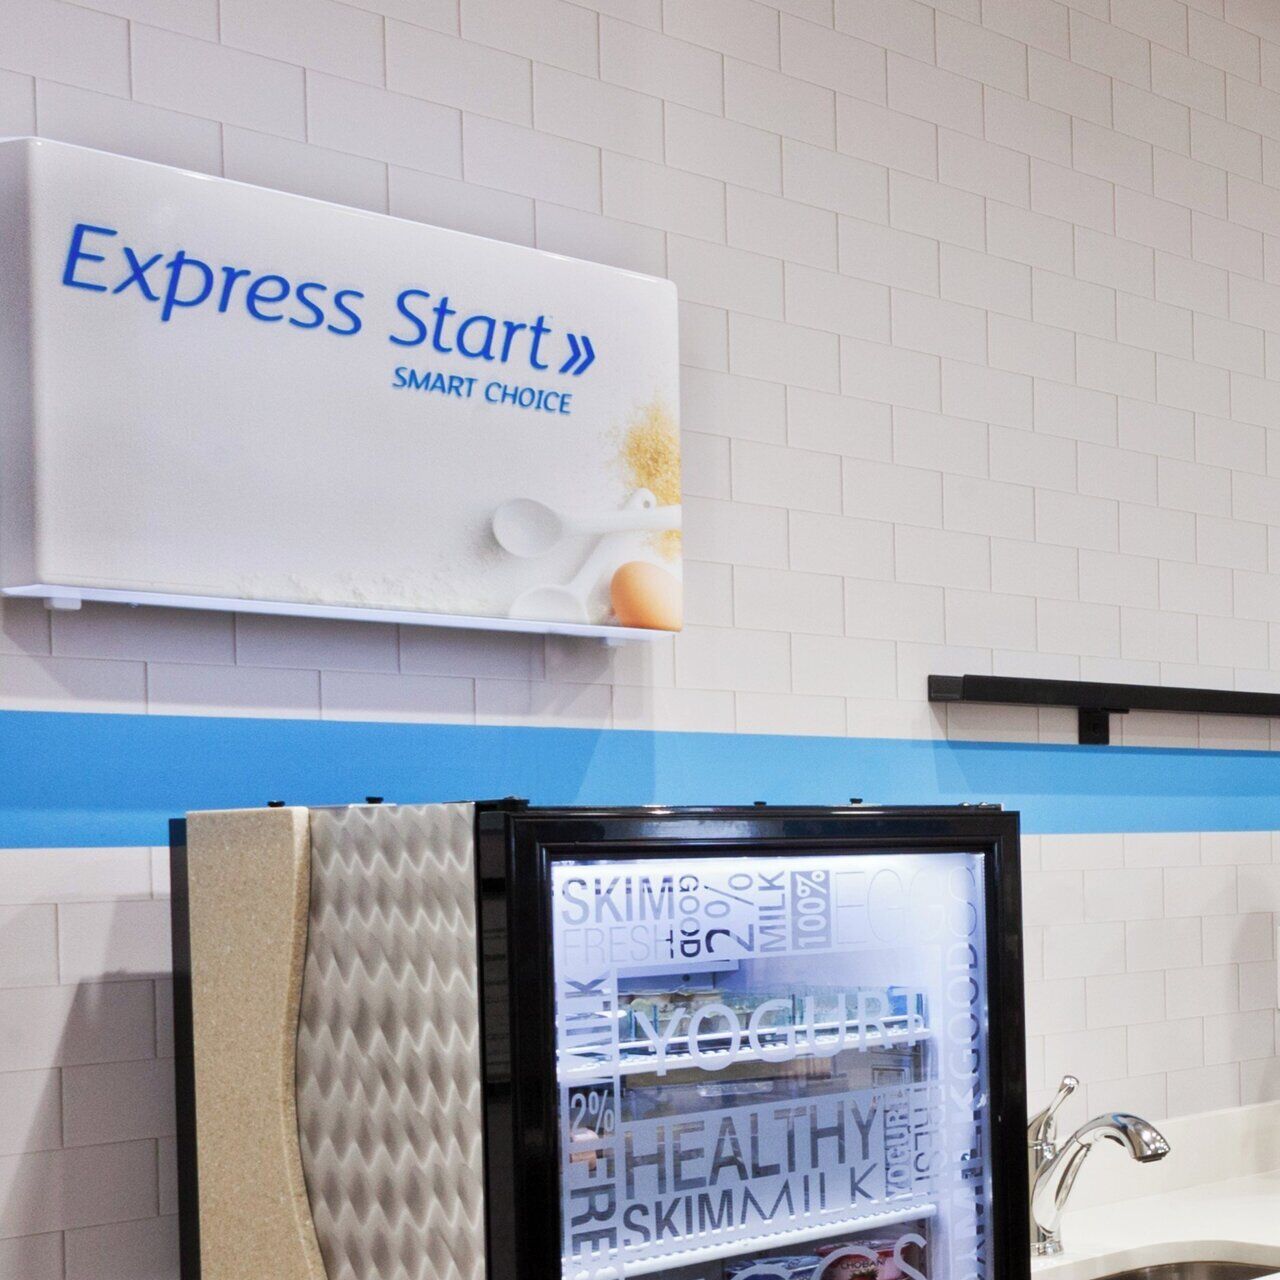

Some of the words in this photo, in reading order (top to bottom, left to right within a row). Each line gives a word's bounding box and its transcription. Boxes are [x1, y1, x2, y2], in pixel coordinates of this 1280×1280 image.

[61, 223, 366, 336] Express
[389, 289, 552, 371] Start
[391, 366, 478, 400] SMART
[484, 381, 573, 414] CHOICE
[562, 875, 675, 925] SKIM
[678, 874, 702, 958] GOOD
[703, 873, 755, 954] 2%
[757, 870, 788, 953] MILK
[795, 869, 828, 949] 100%
[562, 923, 675, 966] FRESH
[634, 983, 930, 1076] YOGURT
[570, 1090, 615, 1142] 2%
[624, 1094, 880, 1200] HEALTHY
[622, 1187, 734, 1247] SKIM
[739, 1162, 879, 1222] MILK
